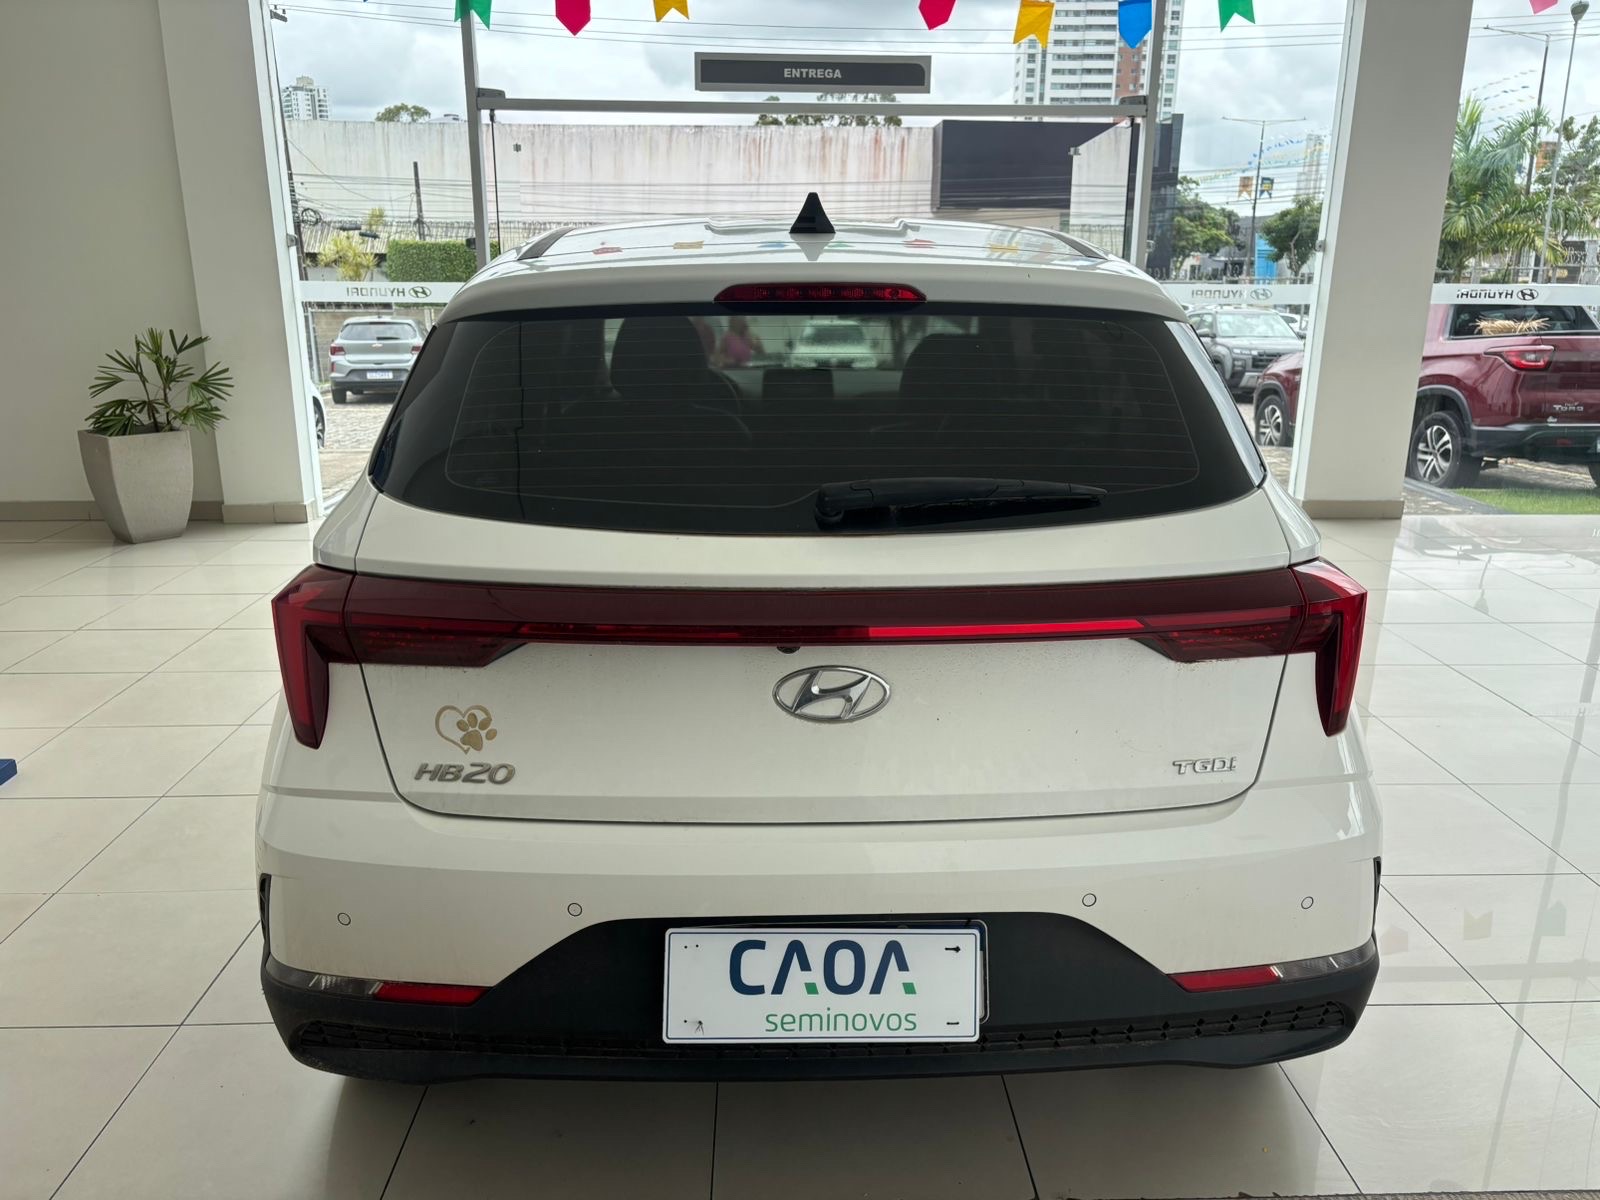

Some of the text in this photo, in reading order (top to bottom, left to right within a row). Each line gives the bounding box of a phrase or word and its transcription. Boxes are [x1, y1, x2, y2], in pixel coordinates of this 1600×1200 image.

[783, 67, 842, 79] ENTREGA
[414, 762, 516, 785] HB20
[729, 939, 917, 996] CAOA
[765, 1007, 917, 1032] seminovos
